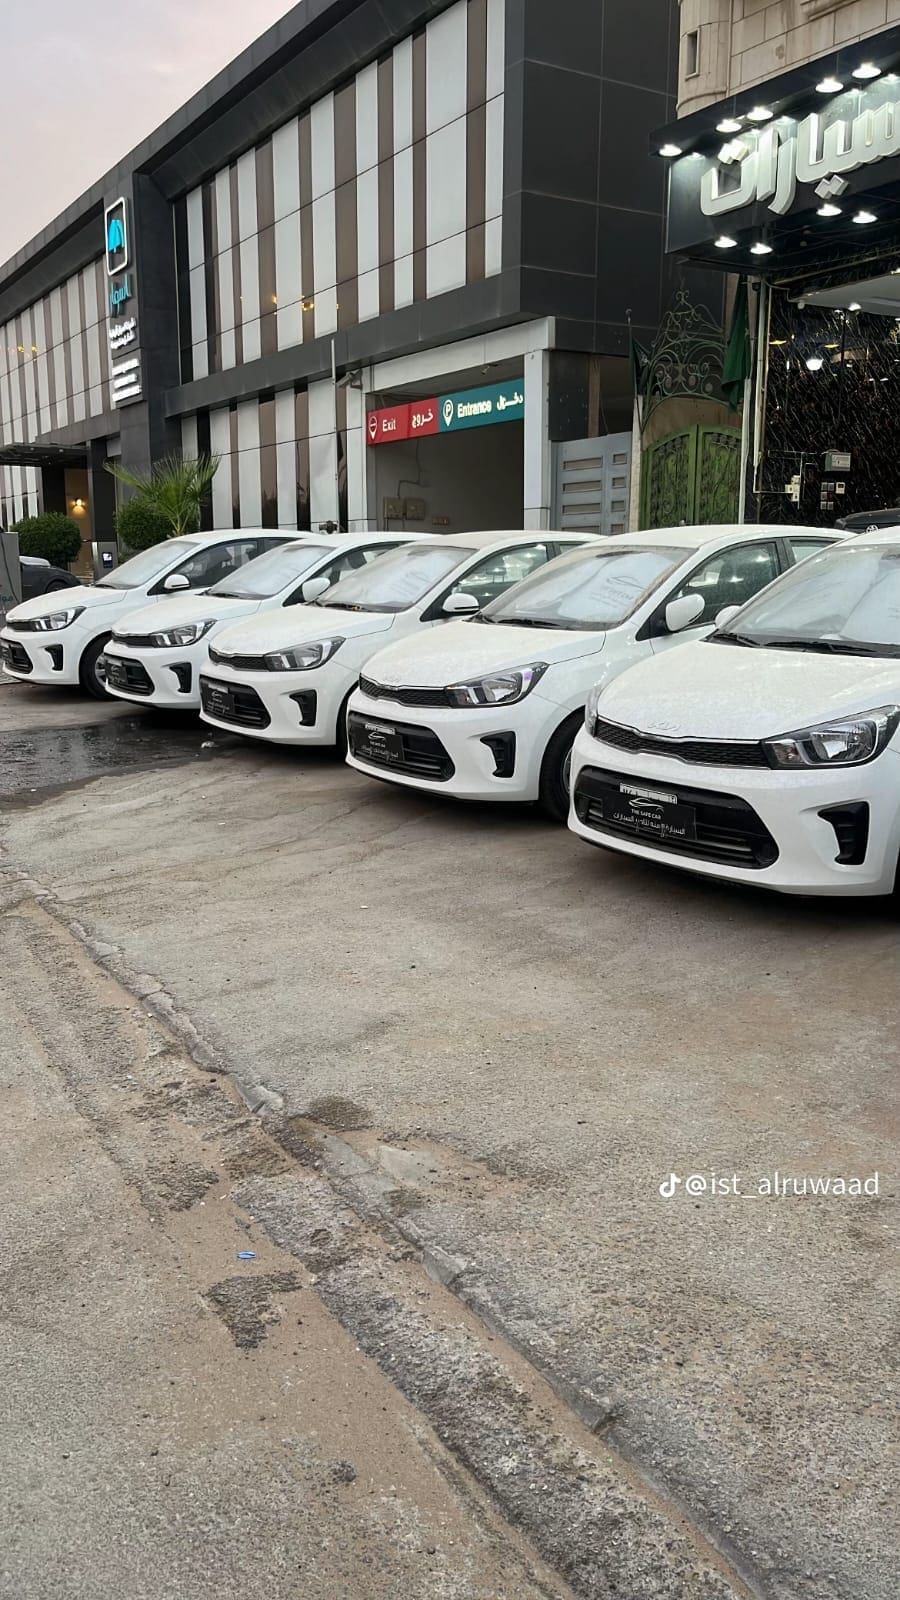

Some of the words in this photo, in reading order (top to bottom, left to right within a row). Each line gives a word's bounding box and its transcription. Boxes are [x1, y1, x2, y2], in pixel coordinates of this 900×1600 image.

[457, 400, 492, 418] Entrance
[496, 391, 524, 411] دخول
[382, 418, 397, 432] Exit
[411, 408, 434, 429] خروج
